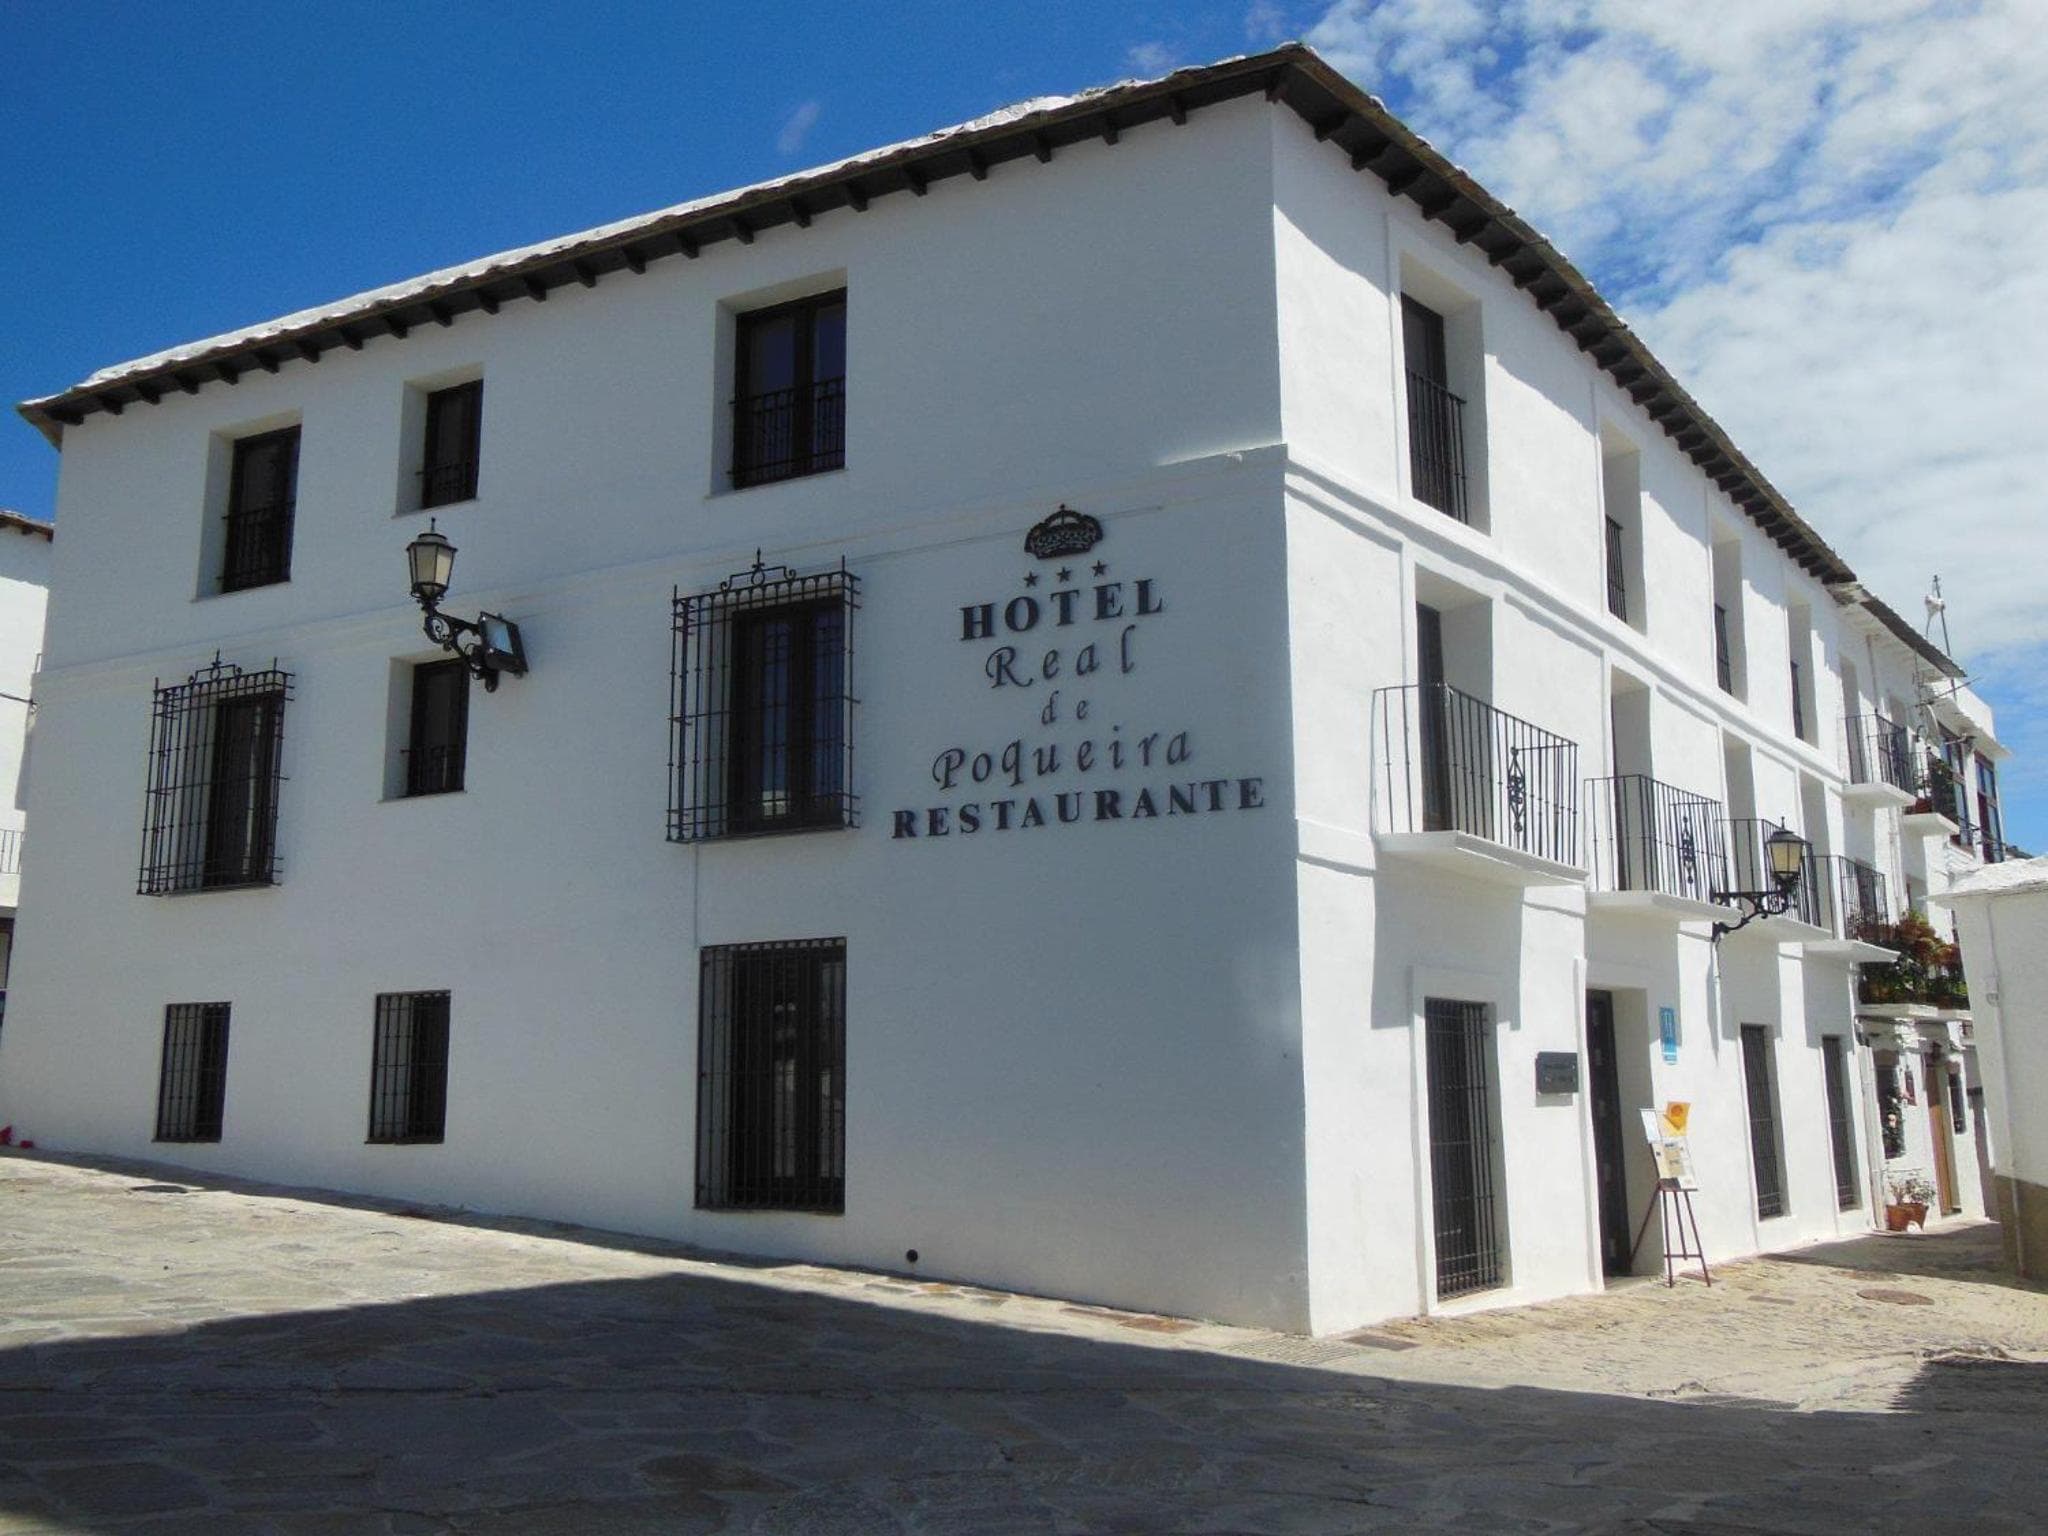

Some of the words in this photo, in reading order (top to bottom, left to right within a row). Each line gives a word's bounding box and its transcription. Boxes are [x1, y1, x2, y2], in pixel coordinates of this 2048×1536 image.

[960, 578, 1164, 641] HOTEL
[985, 624, 1137, 689] Real
[1041, 690, 1089, 726] de
[932, 726, 1193, 790] Poqueira
[891, 777, 1265, 839] RESTAURANTE
